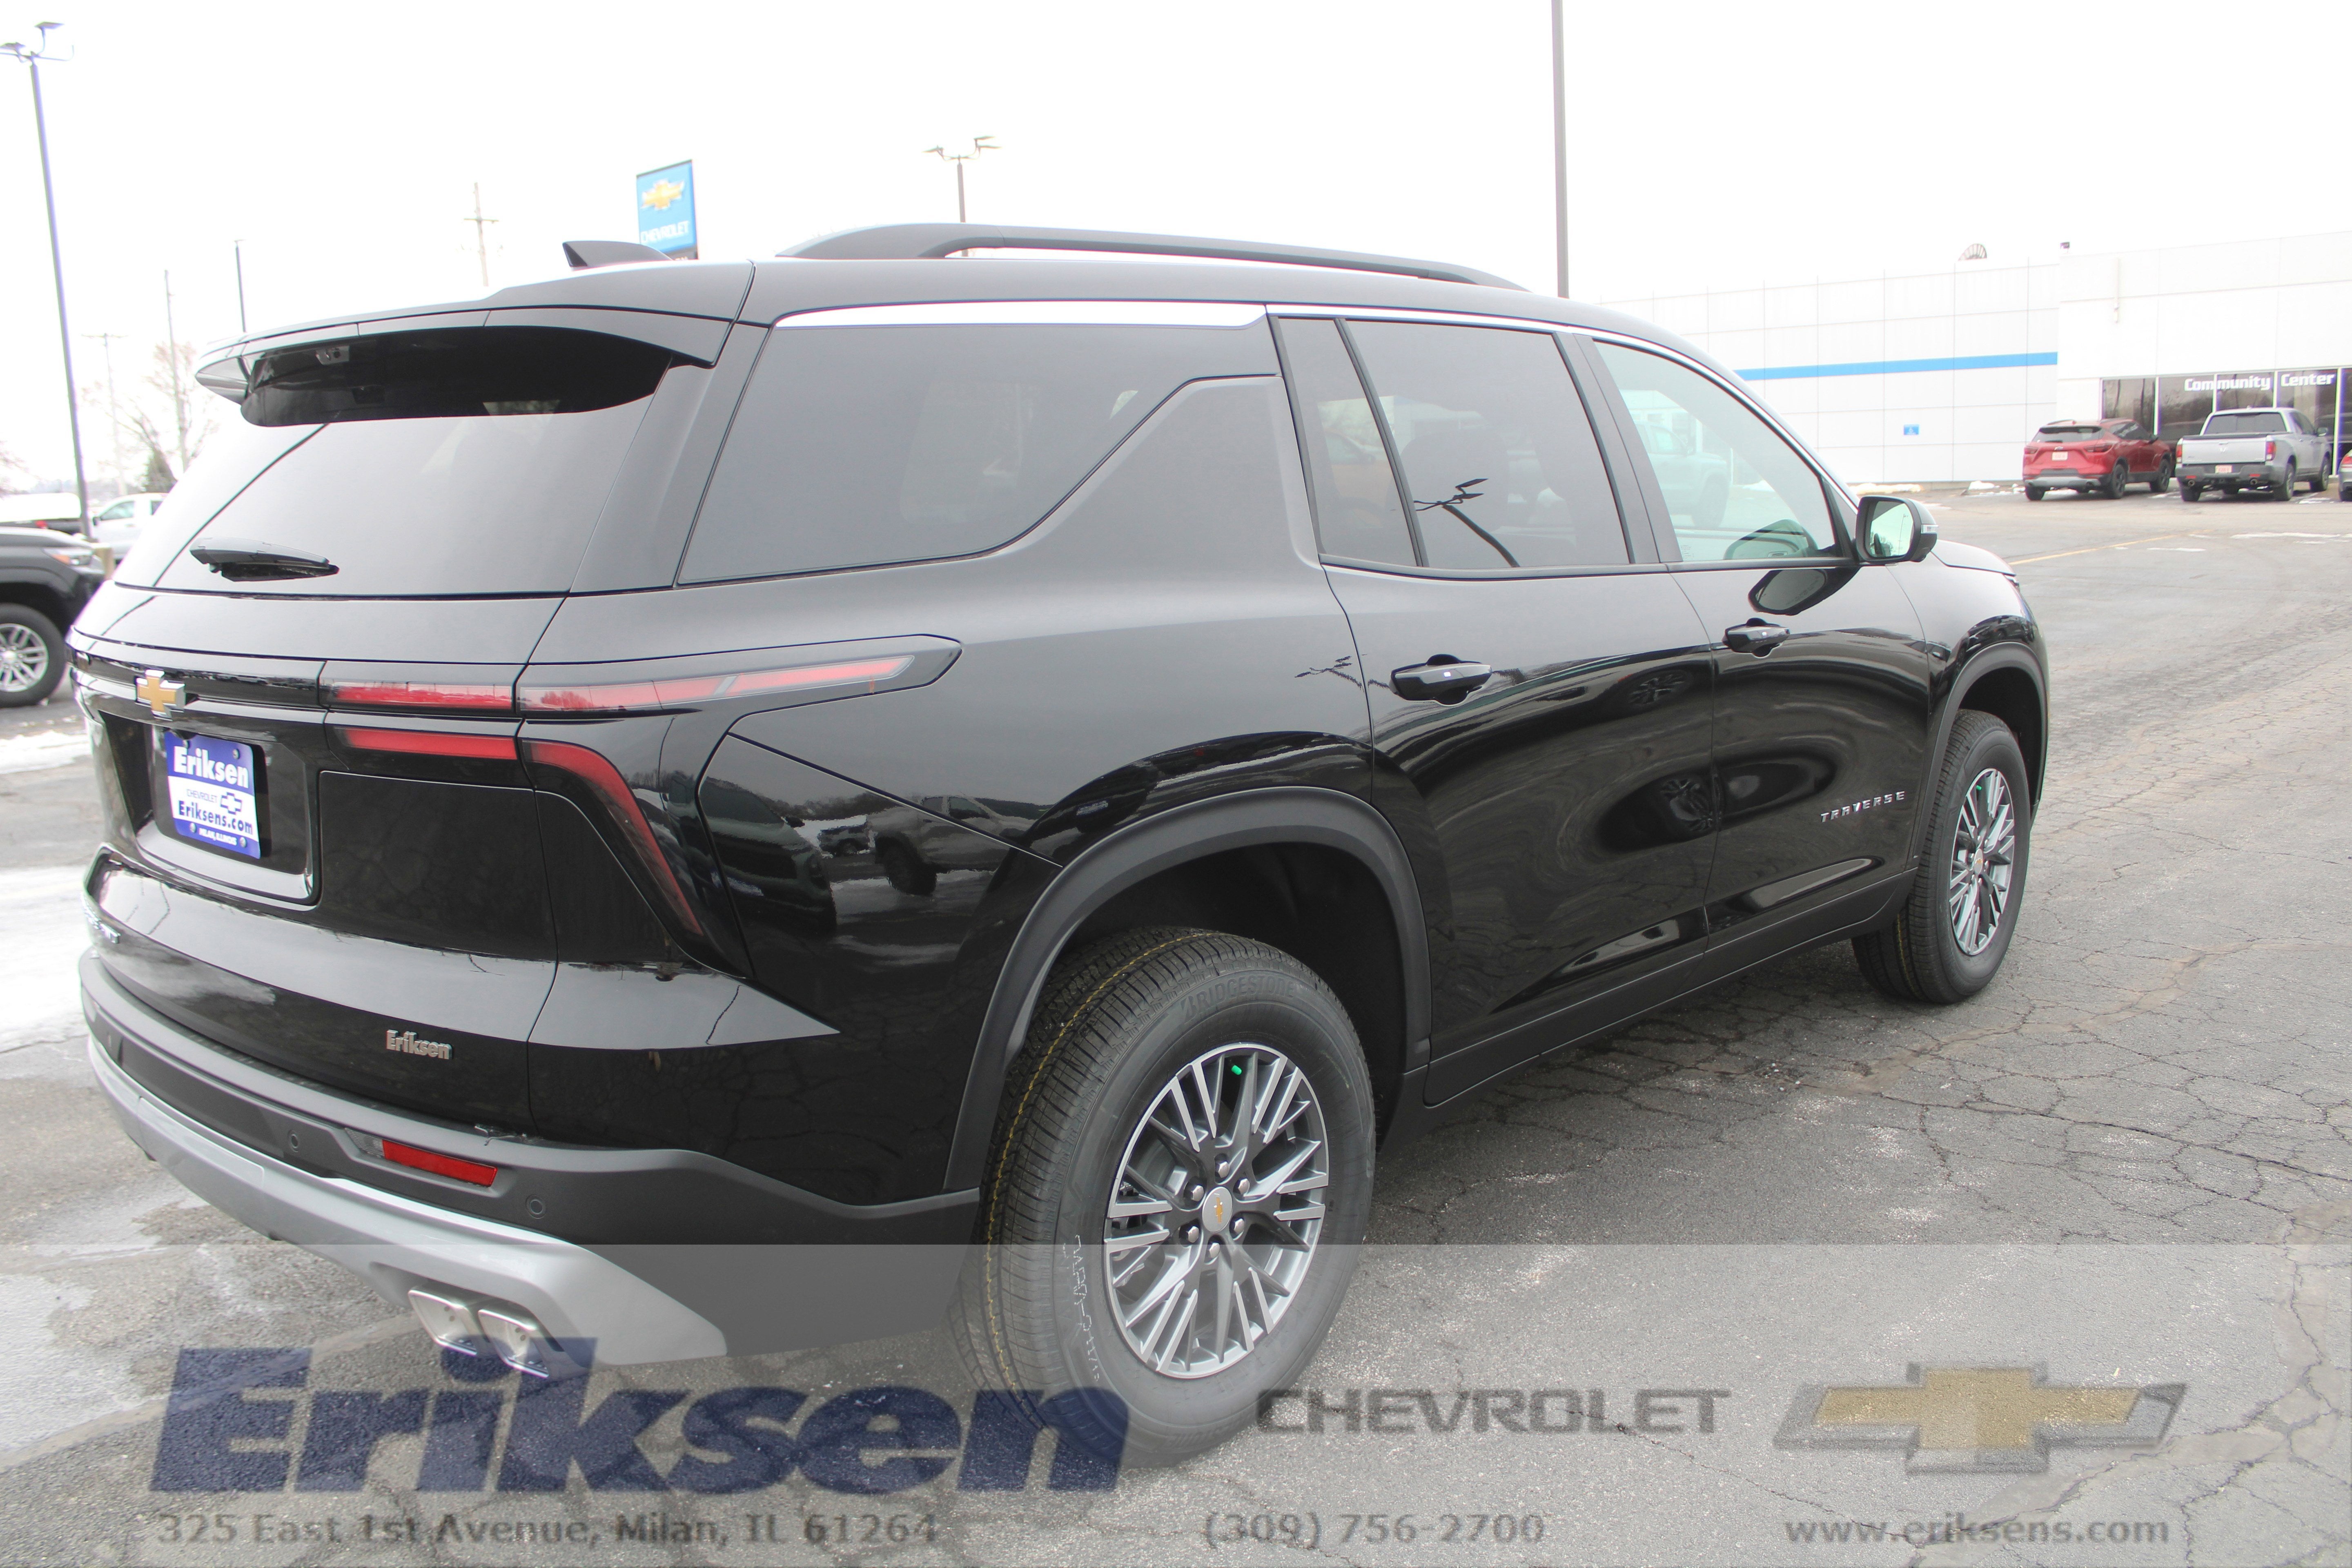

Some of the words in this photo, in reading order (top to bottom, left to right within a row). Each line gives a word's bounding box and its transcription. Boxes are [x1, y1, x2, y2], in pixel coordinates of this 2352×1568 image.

[2185, 375, 2271, 391] Community
[2281, 374, 2335, 386] Center
[174, 745, 249, 788] Eriksen
[178, 800, 253, 835] Eriksens.com
[1820, 791, 1906, 823] TRAVERSE
[1180, 974, 1298, 1020] BRIDGESTONE
[386, 1029, 452, 1060] Eriksen
